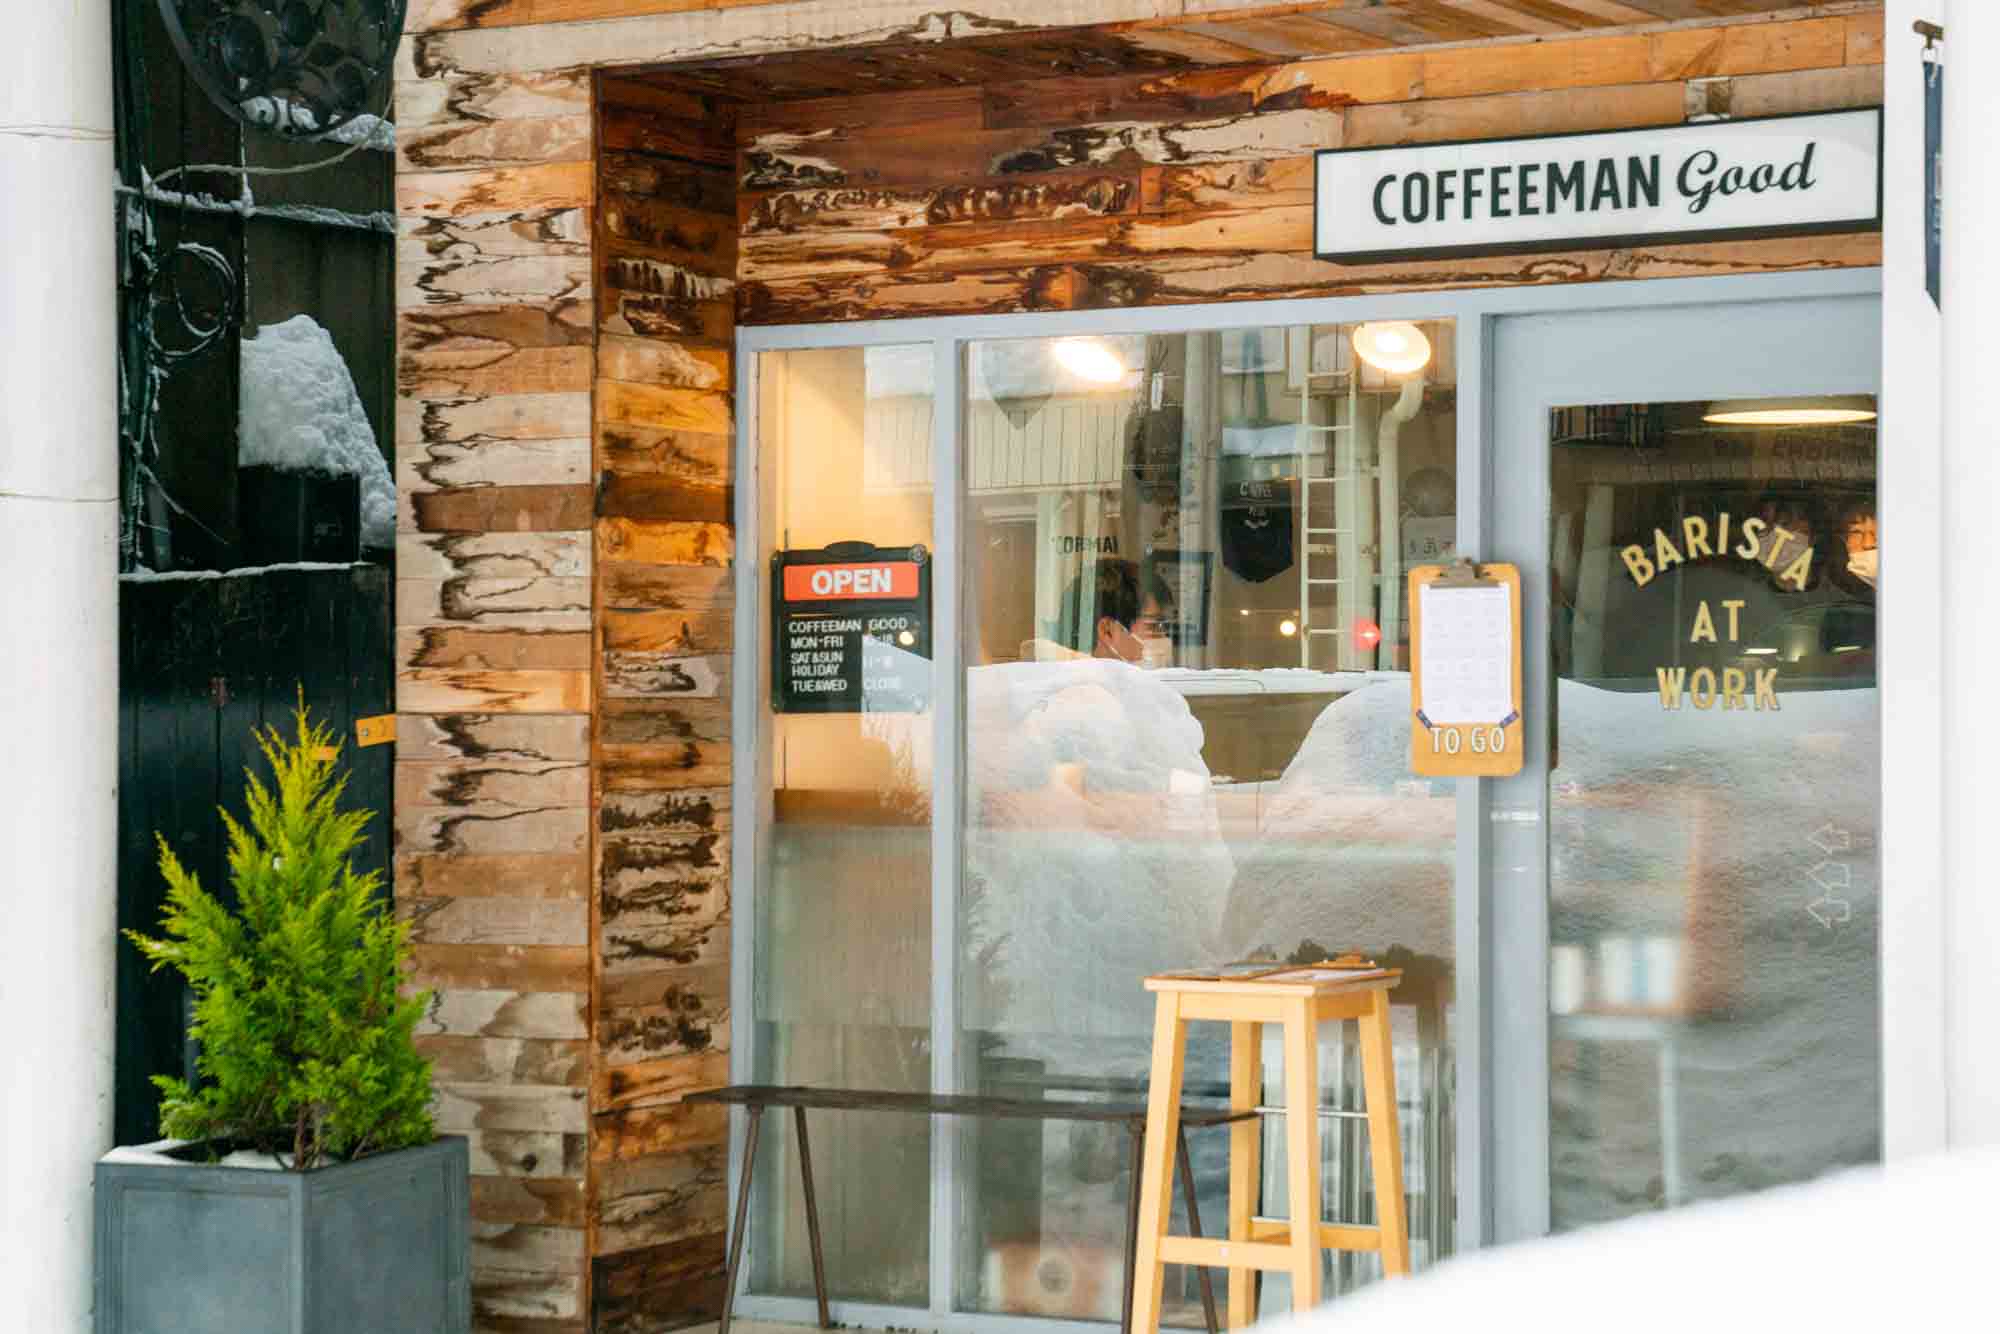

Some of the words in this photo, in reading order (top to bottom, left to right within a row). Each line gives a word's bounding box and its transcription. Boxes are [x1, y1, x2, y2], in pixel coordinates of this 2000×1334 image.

[1373, 154, 1660, 225] COFFEEMAN
[1677, 142, 1817, 214] Good
[1620, 512, 1814, 591] BARISTA
[811, 568, 893, 595] OPEN
[789, 619, 862, 633] COFFEEMAN
[868, 617, 908, 631] GOOD
[1690, 600, 1745, 642] AT
[792, 664, 839, 677] HOLIDAY
[792, 679, 848, 693] TUE&WED
[1656, 667, 1781, 711] WORK
[1431, 727, 1461, 753] TO
[1471, 727, 1505, 753] GO
